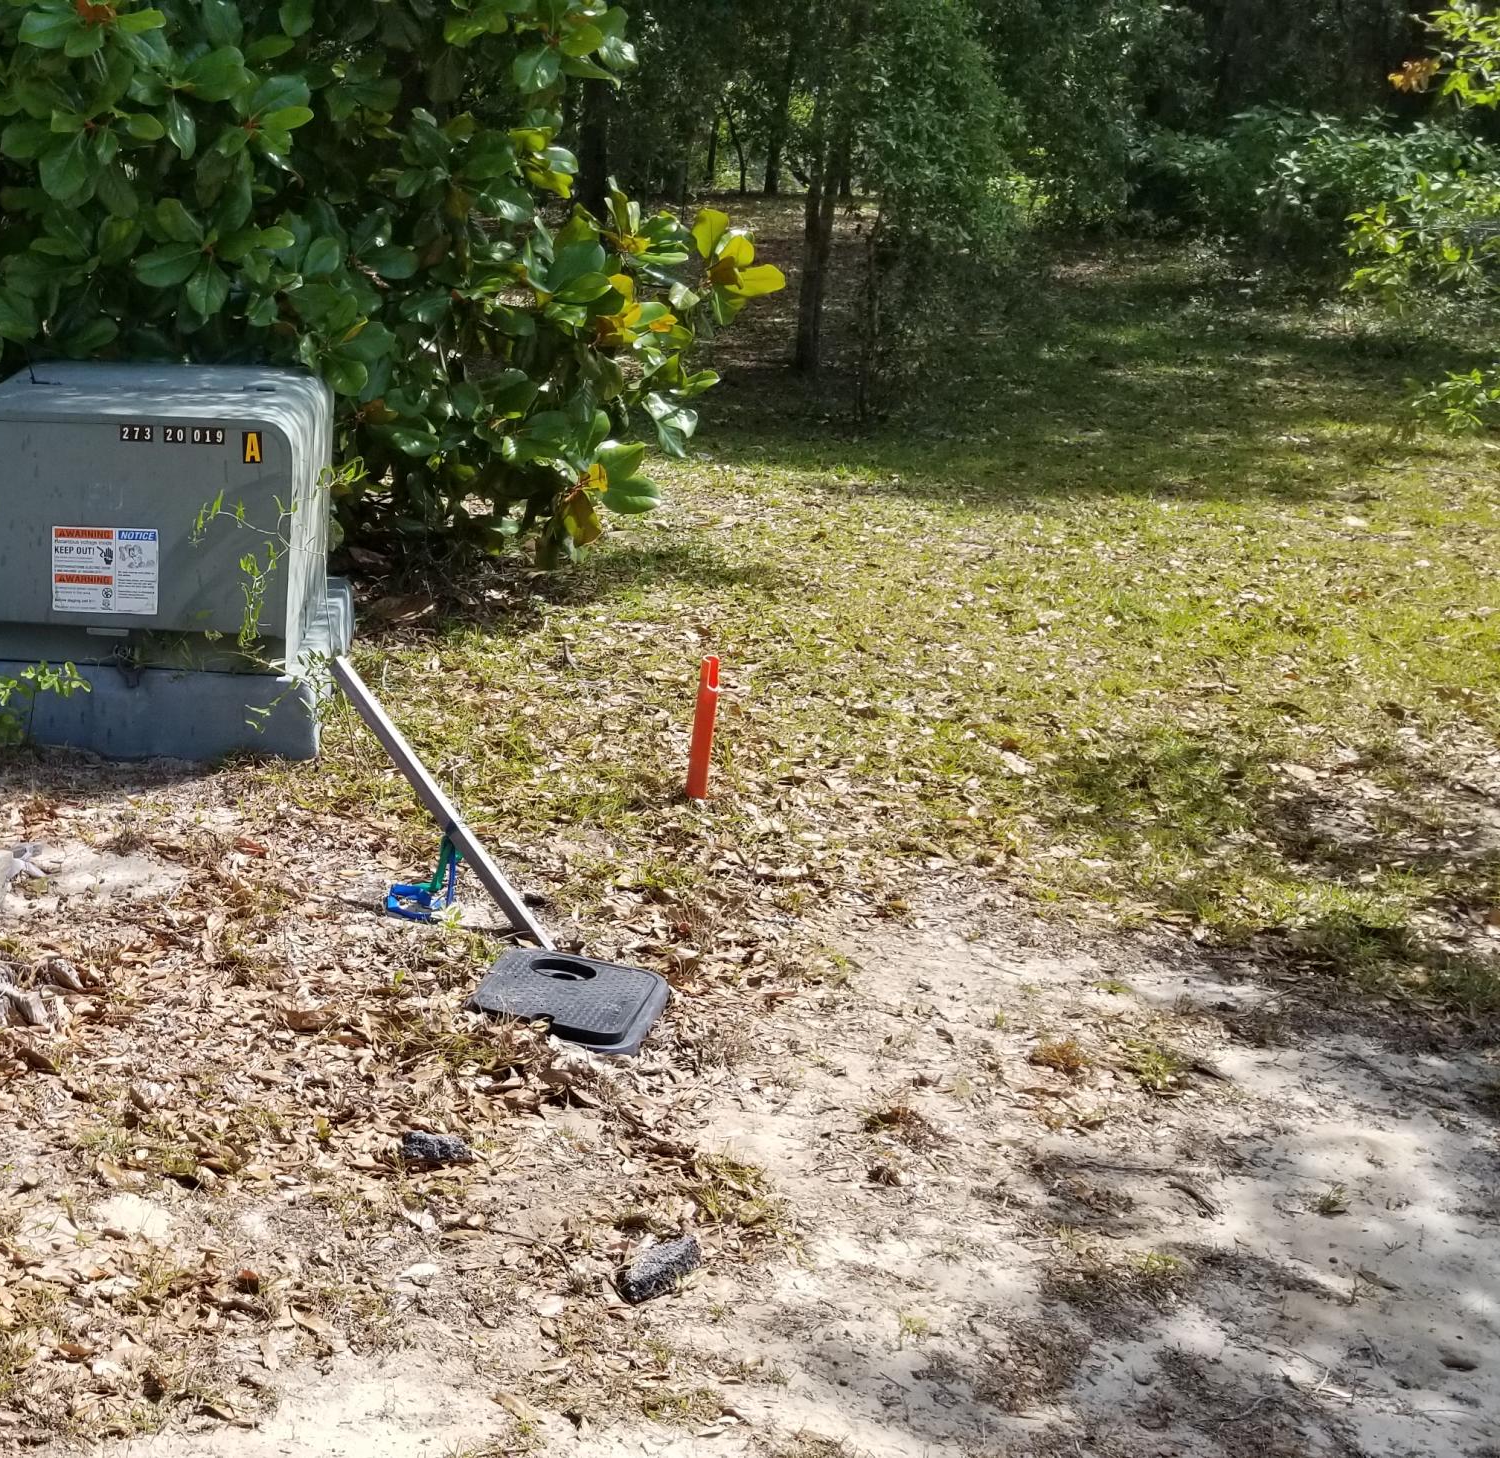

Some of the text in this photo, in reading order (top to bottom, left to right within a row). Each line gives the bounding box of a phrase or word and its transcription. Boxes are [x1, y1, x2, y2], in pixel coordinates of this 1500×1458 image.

[122, 427, 223, 443] 273 20 019
[245, 432, 261, 463] A
[66, 529, 112, 539] WARNING
[120, 531, 155, 540] NOTICE
[54, 546, 95, 556] KEEP OUT!
[66, 575, 110, 584] WARNING
